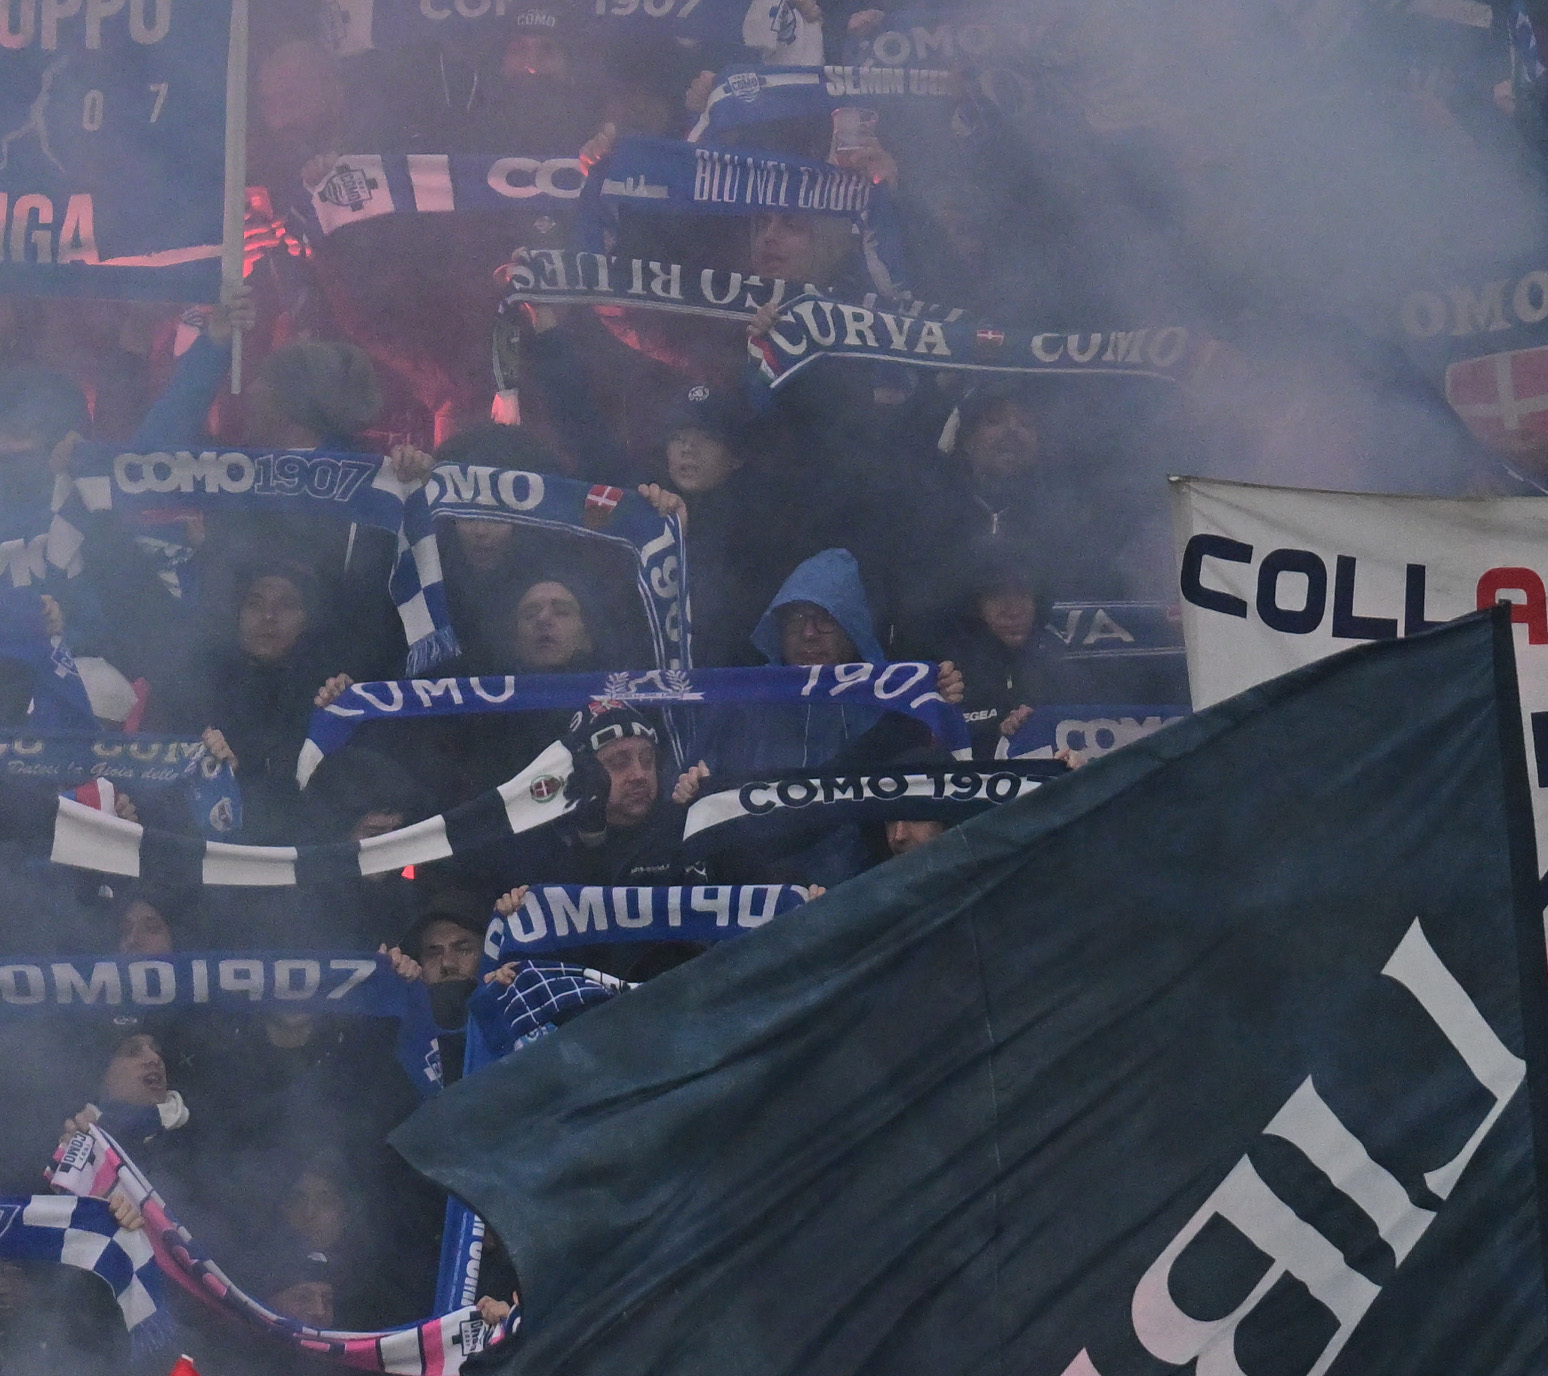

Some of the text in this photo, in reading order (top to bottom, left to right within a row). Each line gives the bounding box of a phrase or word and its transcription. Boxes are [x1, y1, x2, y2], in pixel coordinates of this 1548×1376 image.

[770, 297, 1190, 370] CURVA COMO
[737, 776, 911, 817] COMO
